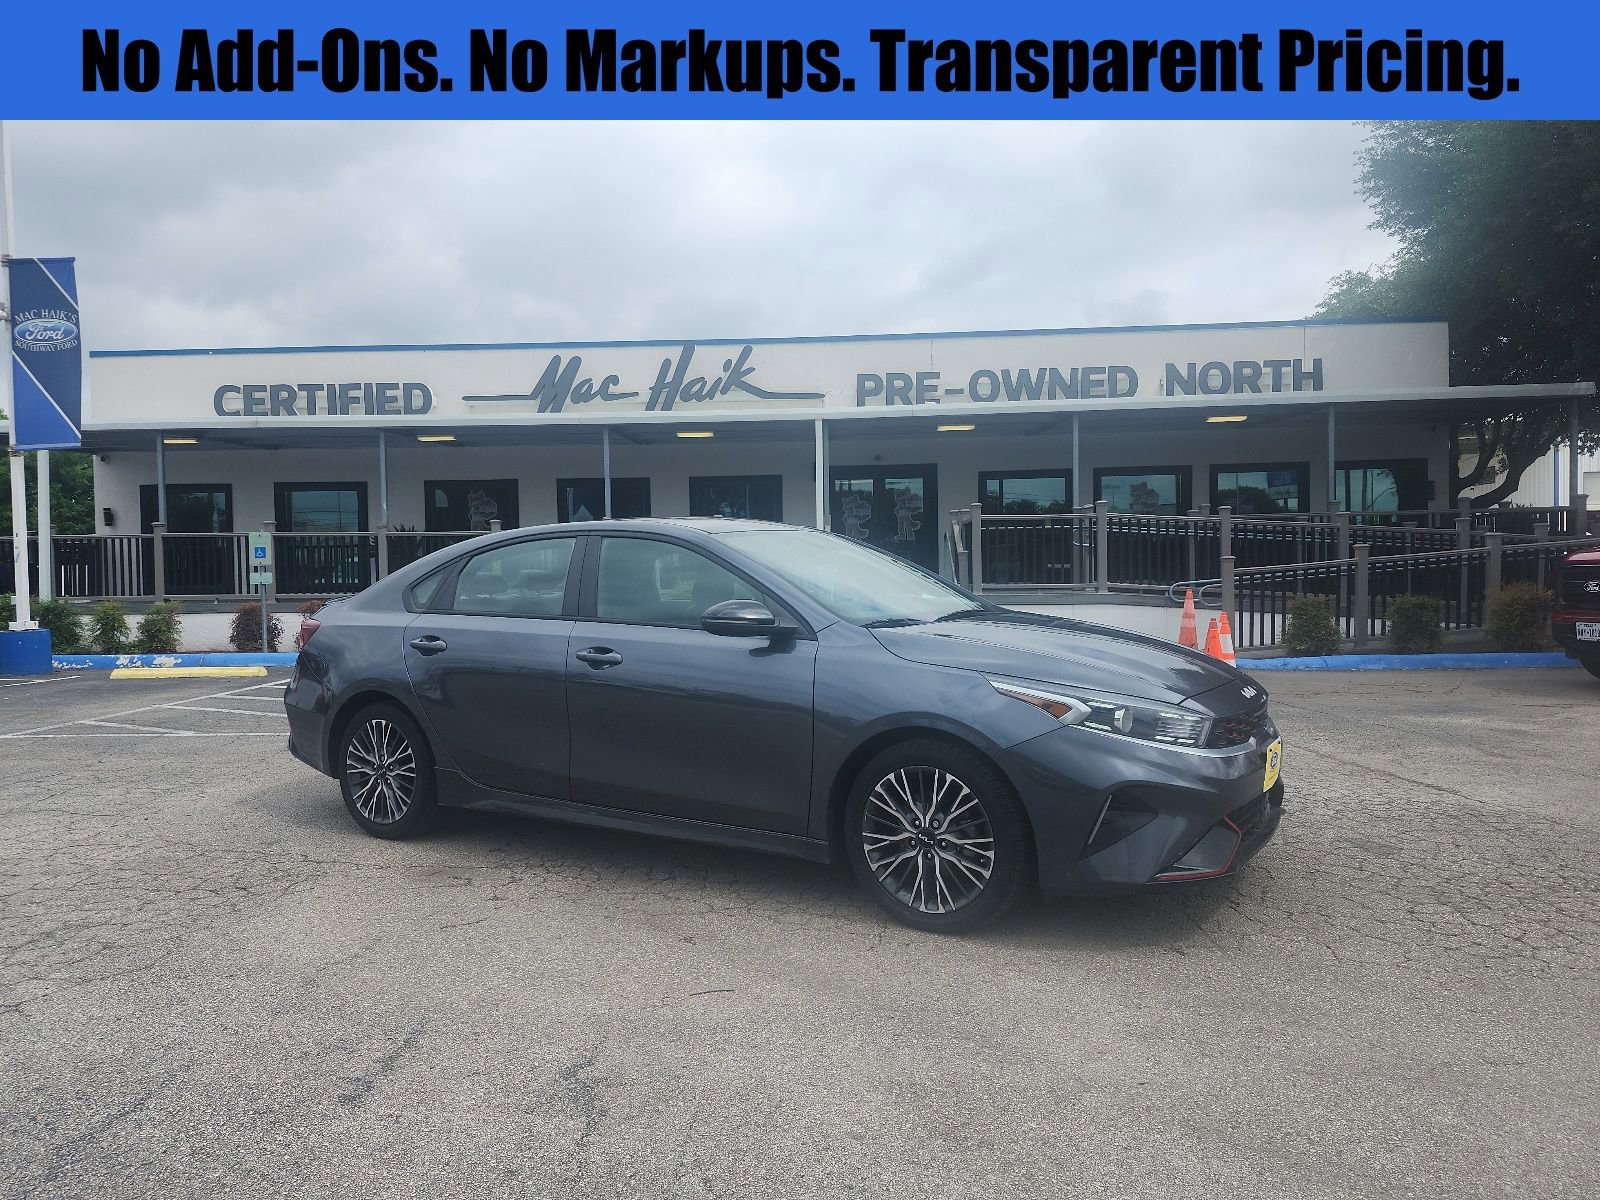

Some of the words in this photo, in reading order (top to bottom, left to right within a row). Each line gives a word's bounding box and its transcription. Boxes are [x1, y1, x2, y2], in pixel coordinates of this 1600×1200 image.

[15, 309, 38, 324] MAC
[41, 308, 78, 323] HAIK'S
[25, 322, 65, 340] Ford
[56, 339, 78, 351] FORD
[531, 354, 640, 413] Mac
[644, 343, 768, 412] Haik
[856, 365, 1139, 408] PRE-OWNED
[1164, 358, 1324, 397] NORTH
[213, 382, 433, 417] CERTIFIED
